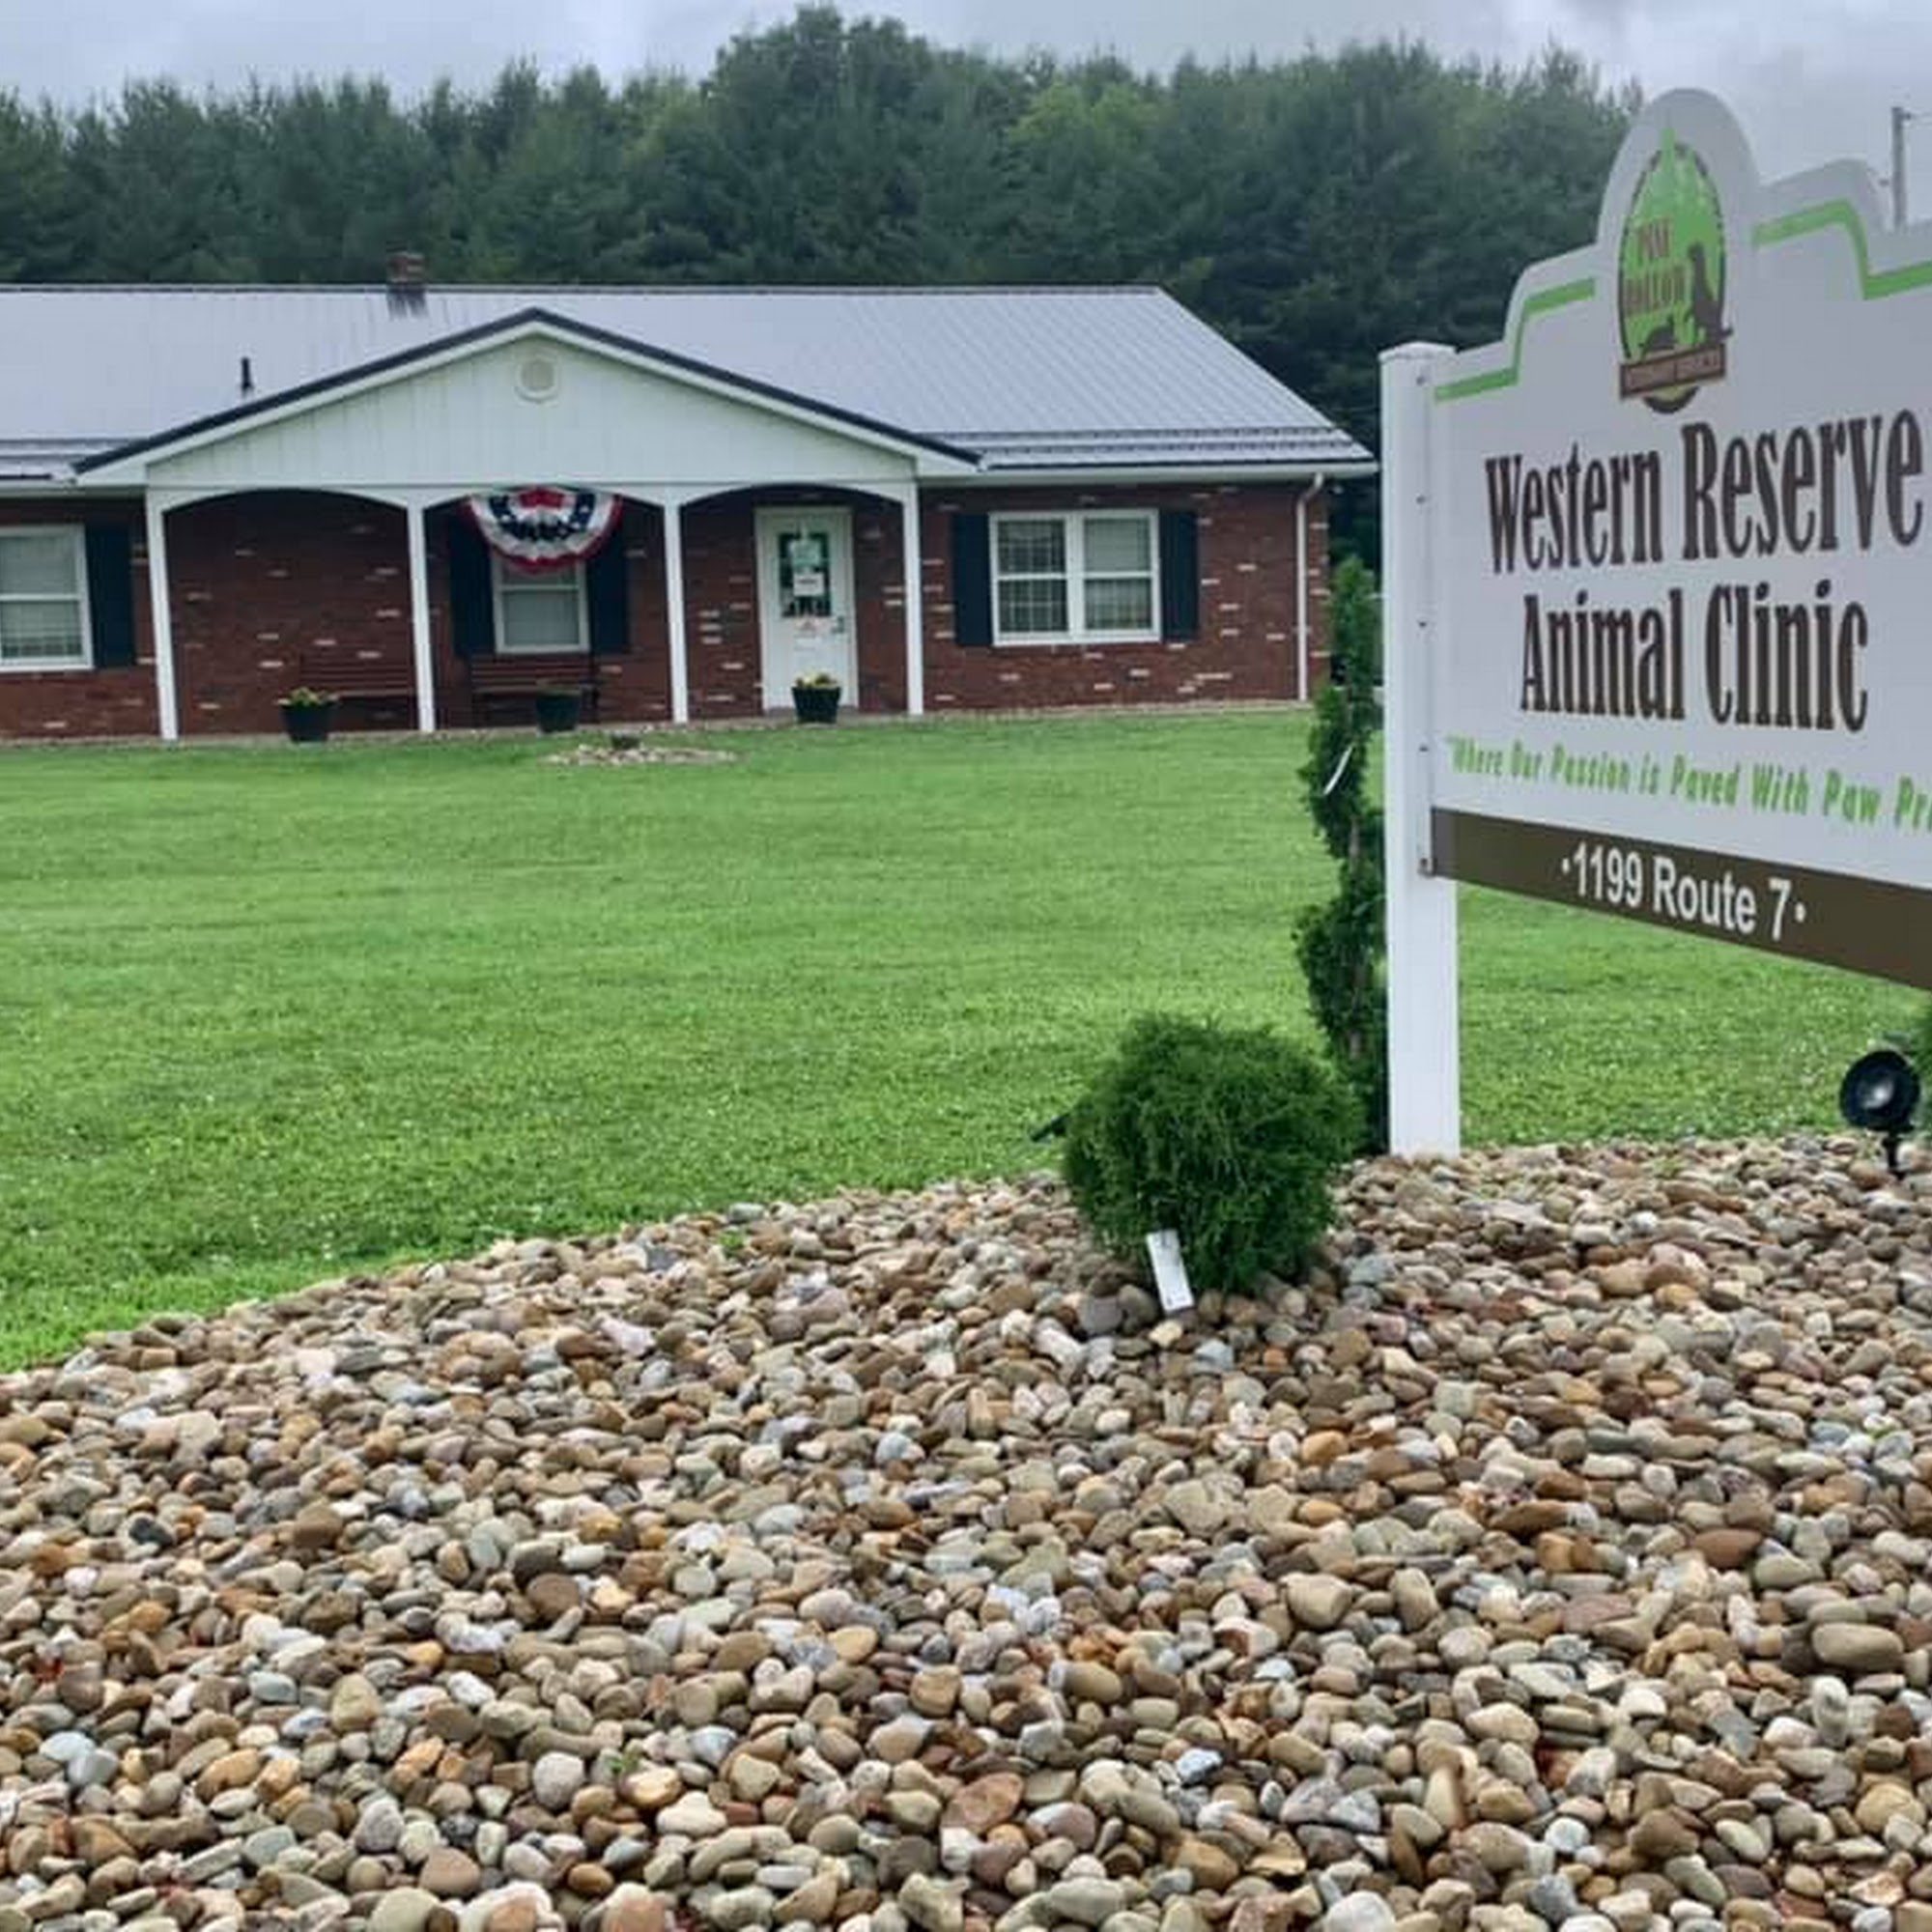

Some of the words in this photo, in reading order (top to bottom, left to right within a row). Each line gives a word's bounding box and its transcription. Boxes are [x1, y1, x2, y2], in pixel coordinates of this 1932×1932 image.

[1485, 443, 1662, 574] Western
[1682, 409, 1923, 561] Reserve
[1520, 586, 1685, 721] Animal
[1705, 580, 1868, 733] Clinic
[1511, 738, 1543, 780] Our
[1550, 743, 1630, 794] Passion
[1670, 753, 1742, 807] Paved
[1751, 761, 1809, 815] With
[1822, 768, 1882, 822] Paw
[1653, 856, 1757, 934] Route
